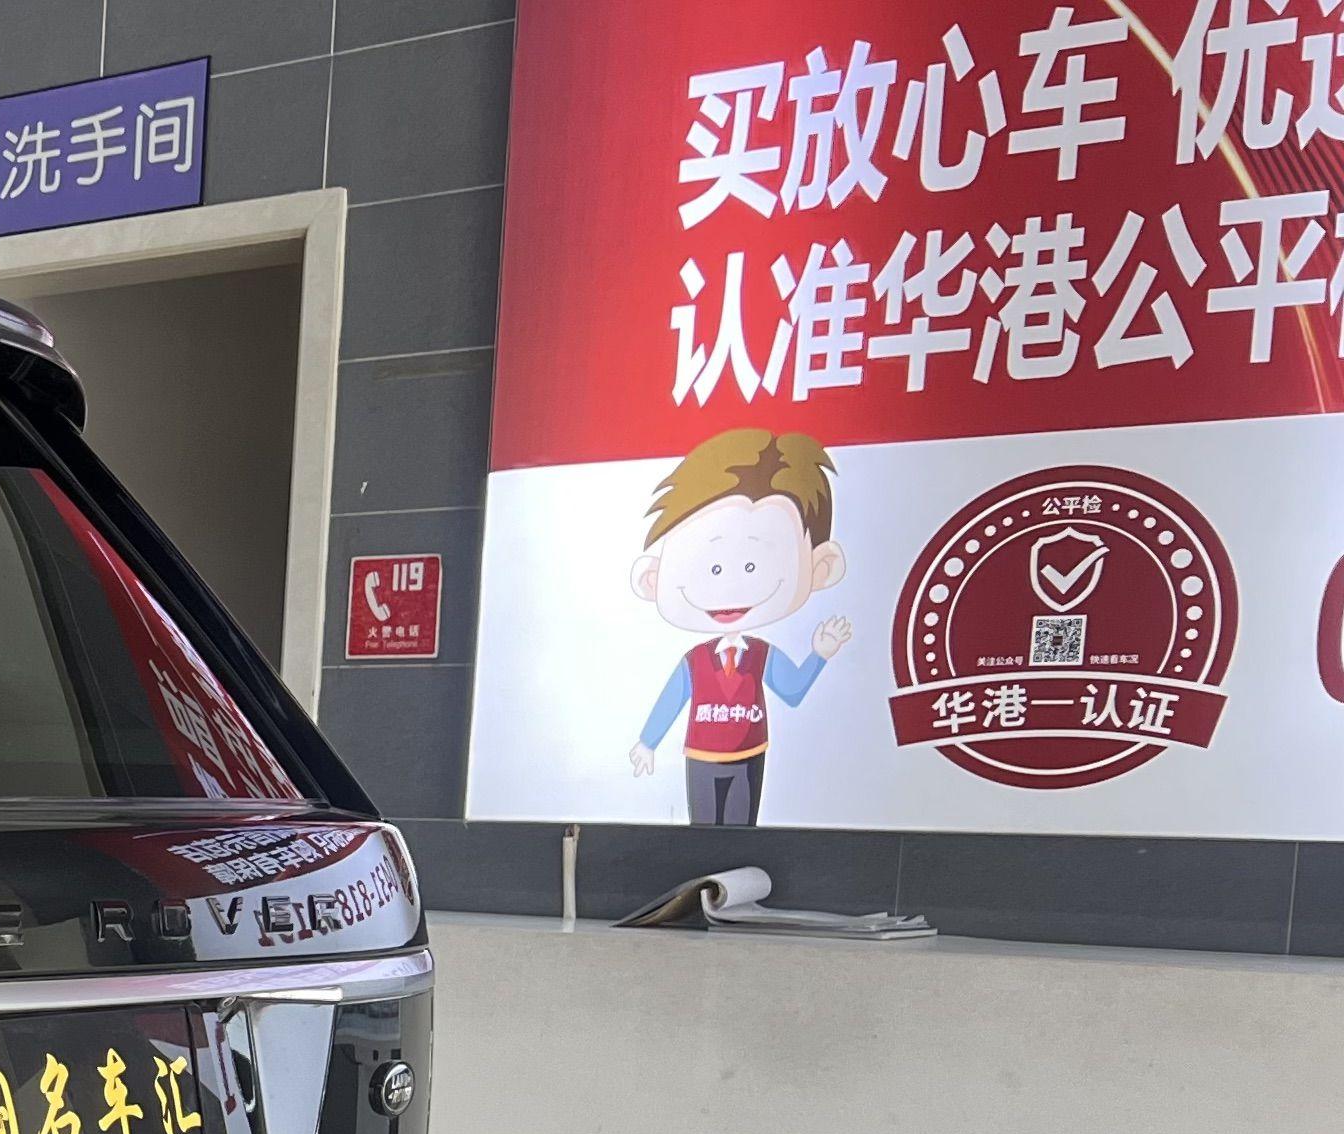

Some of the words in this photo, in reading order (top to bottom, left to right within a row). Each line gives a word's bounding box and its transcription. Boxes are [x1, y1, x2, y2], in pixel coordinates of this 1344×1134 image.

[678, 6, 1130, 230] 买放心车
[0, 96, 197, 200] 洗手间
[670, 189, 1344, 408] 认准华港公平
[1042, 495, 1102, 517] 公平检
[393, 561, 425, 592] 119
[695, 703, 764, 723] 质检中心
[90, 895, 345, 944] ROVER
